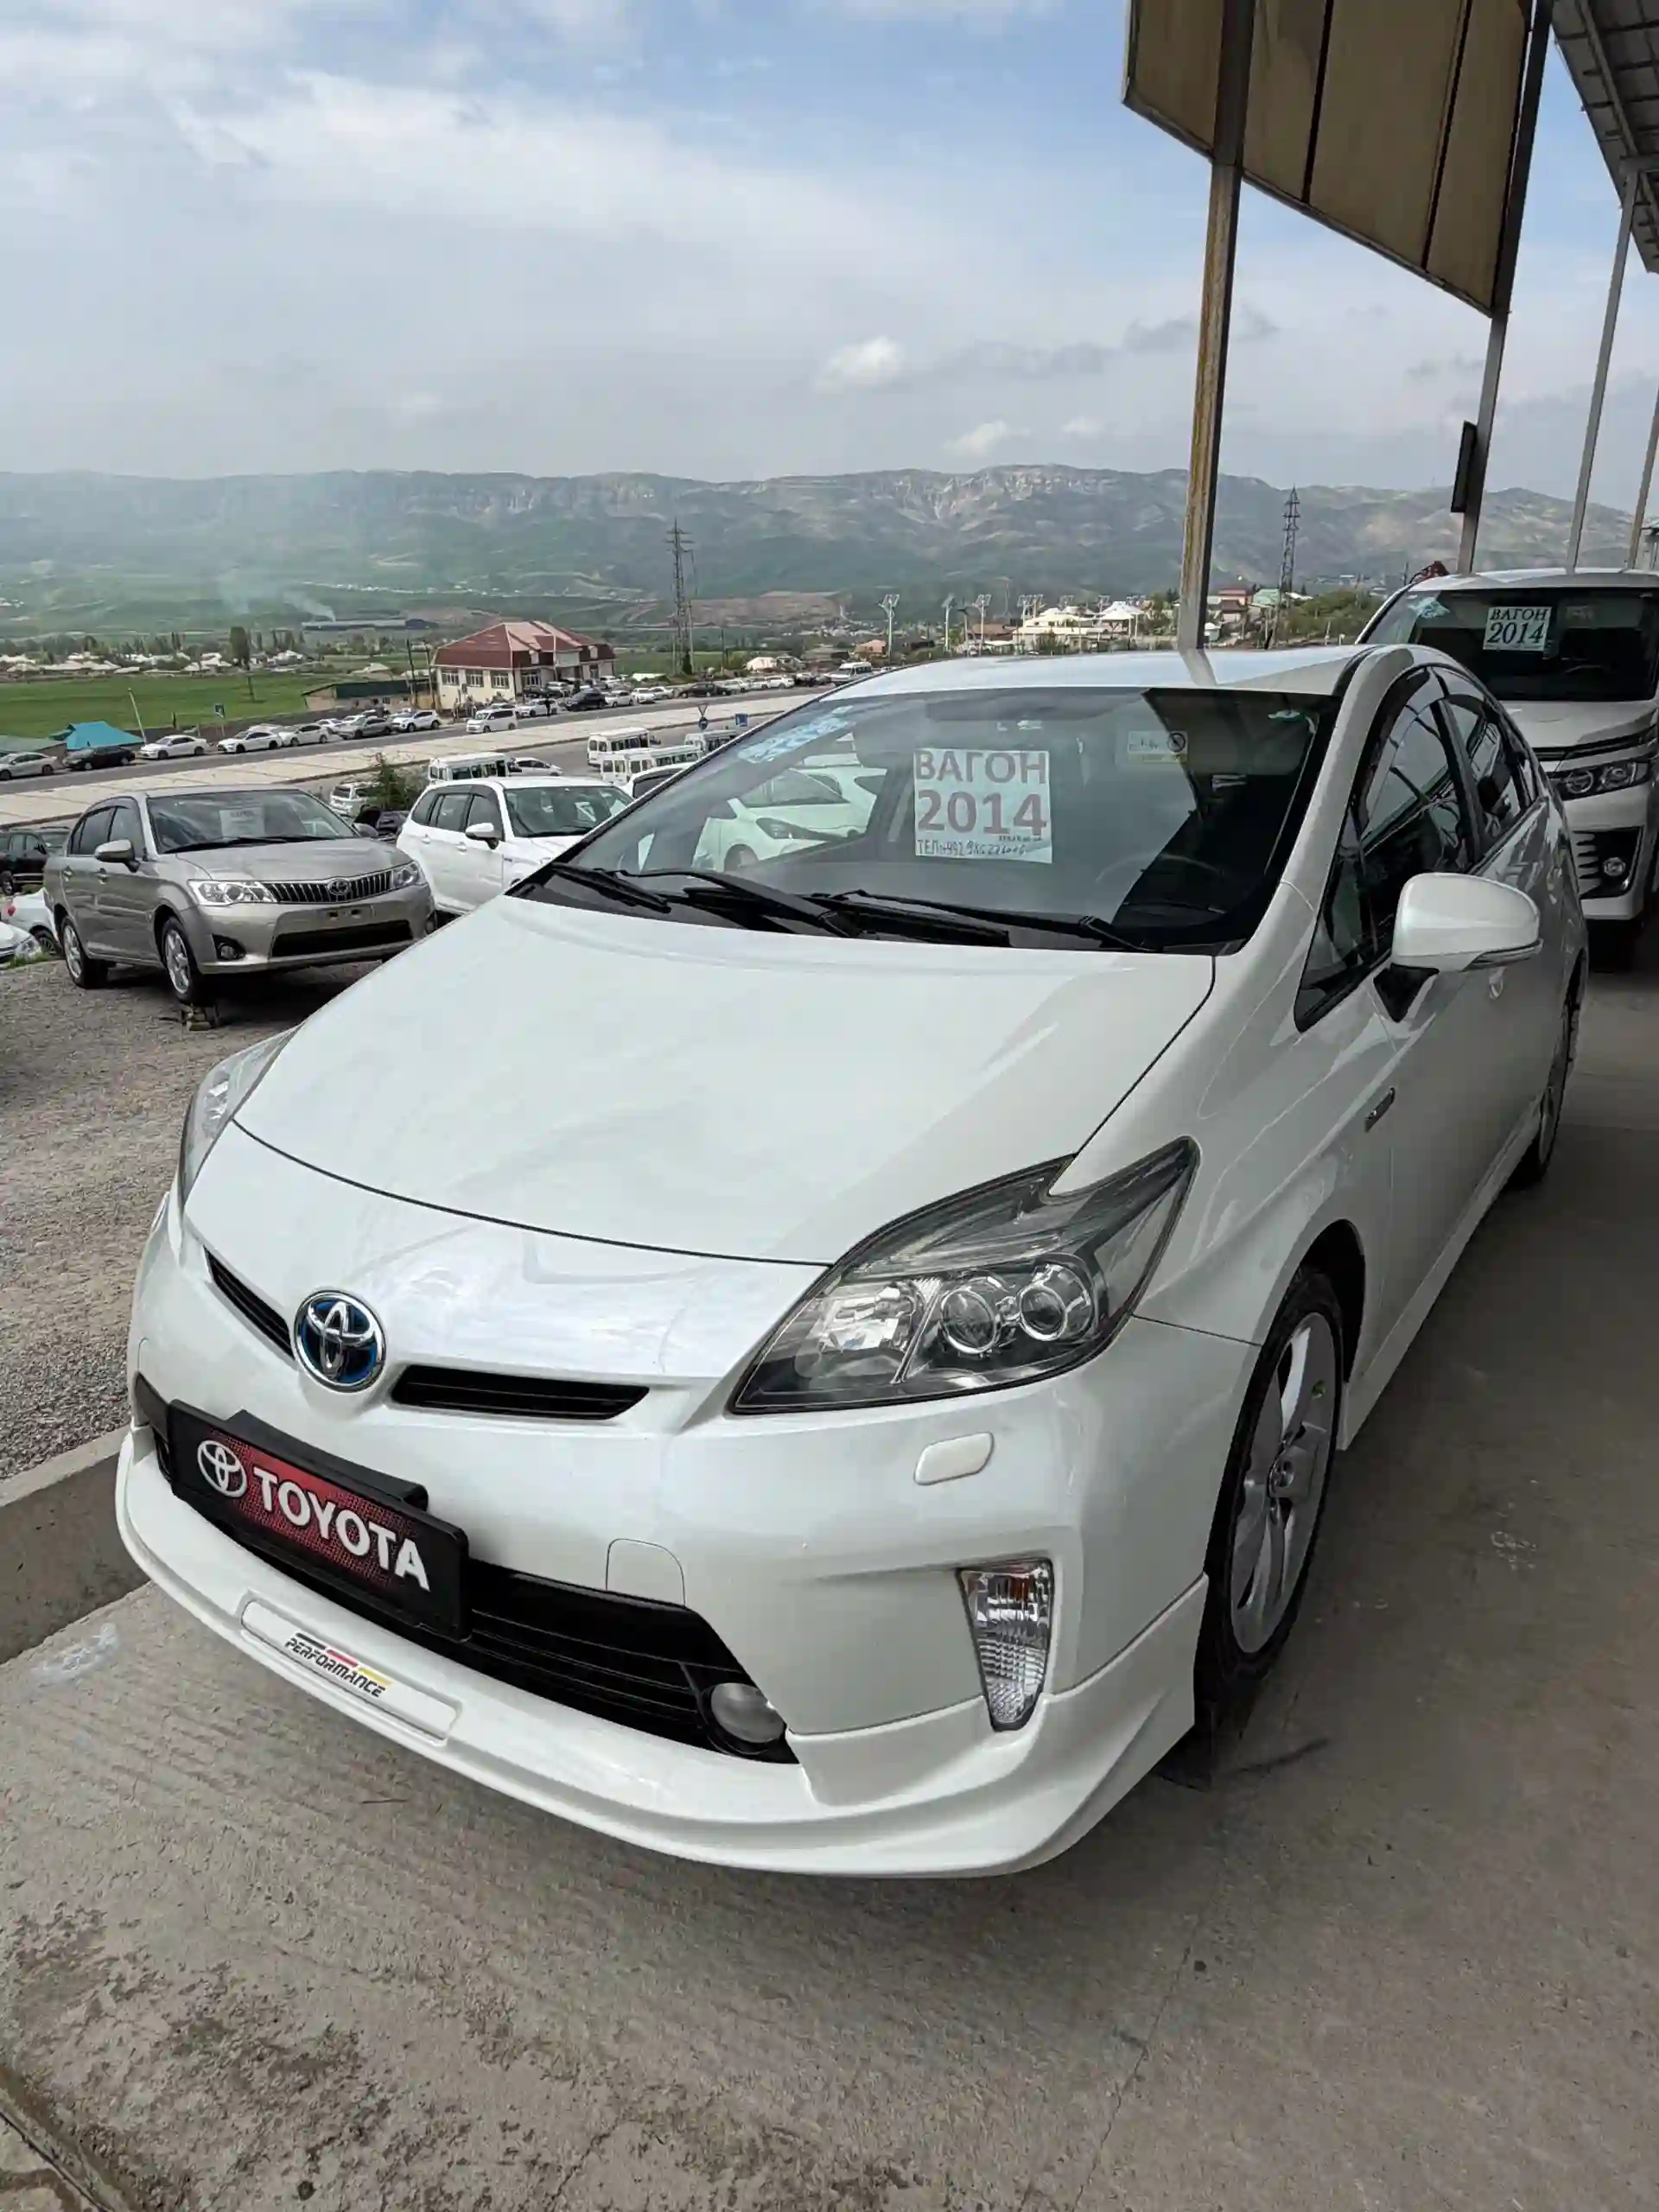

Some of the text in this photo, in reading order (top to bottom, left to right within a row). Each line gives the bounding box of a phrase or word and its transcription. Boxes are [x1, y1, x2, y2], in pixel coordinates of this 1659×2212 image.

[1487, 622, 1545, 644] 2014
[1490, 608, 1548, 620] ВАГОН
[916, 750, 1047, 784] ВАГОН
[918, 790, 1047, 836] 2014
[254, 1467, 430, 1592] TOYOTA
[285, 1637, 386, 1698] PERFORMANCE
